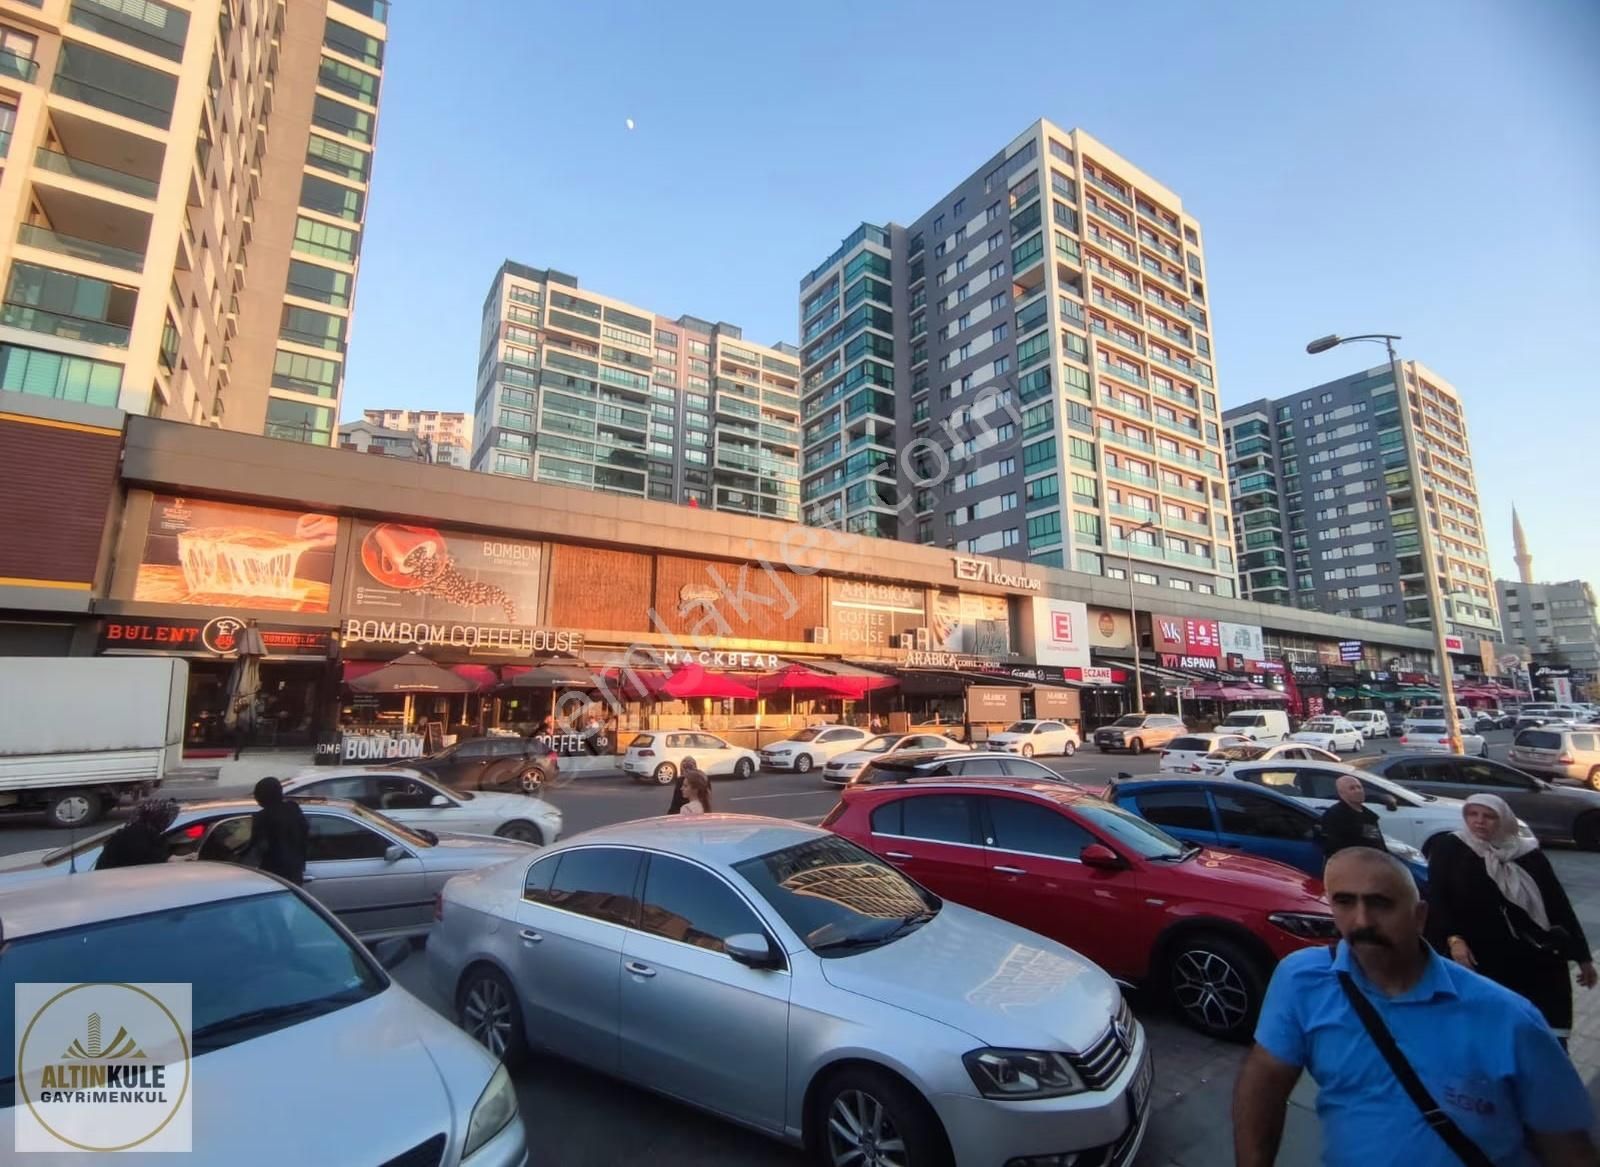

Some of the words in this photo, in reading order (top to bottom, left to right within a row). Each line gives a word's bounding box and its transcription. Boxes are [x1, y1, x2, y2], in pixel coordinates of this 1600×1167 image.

[483, 541, 541, 561] BOMBOM
[994, 573, 1040, 591] KONUTLARI
[838, 610, 886, 626] COFFEE
[840, 629, 886, 643] HOUSE
[664, 651, 779, 668] MACKBEAR
[904, 651, 959, 671] ARABICA
[1180, 656, 1216, 669] ASPAVA
[1084, 668, 1111, 678] ECZANE
